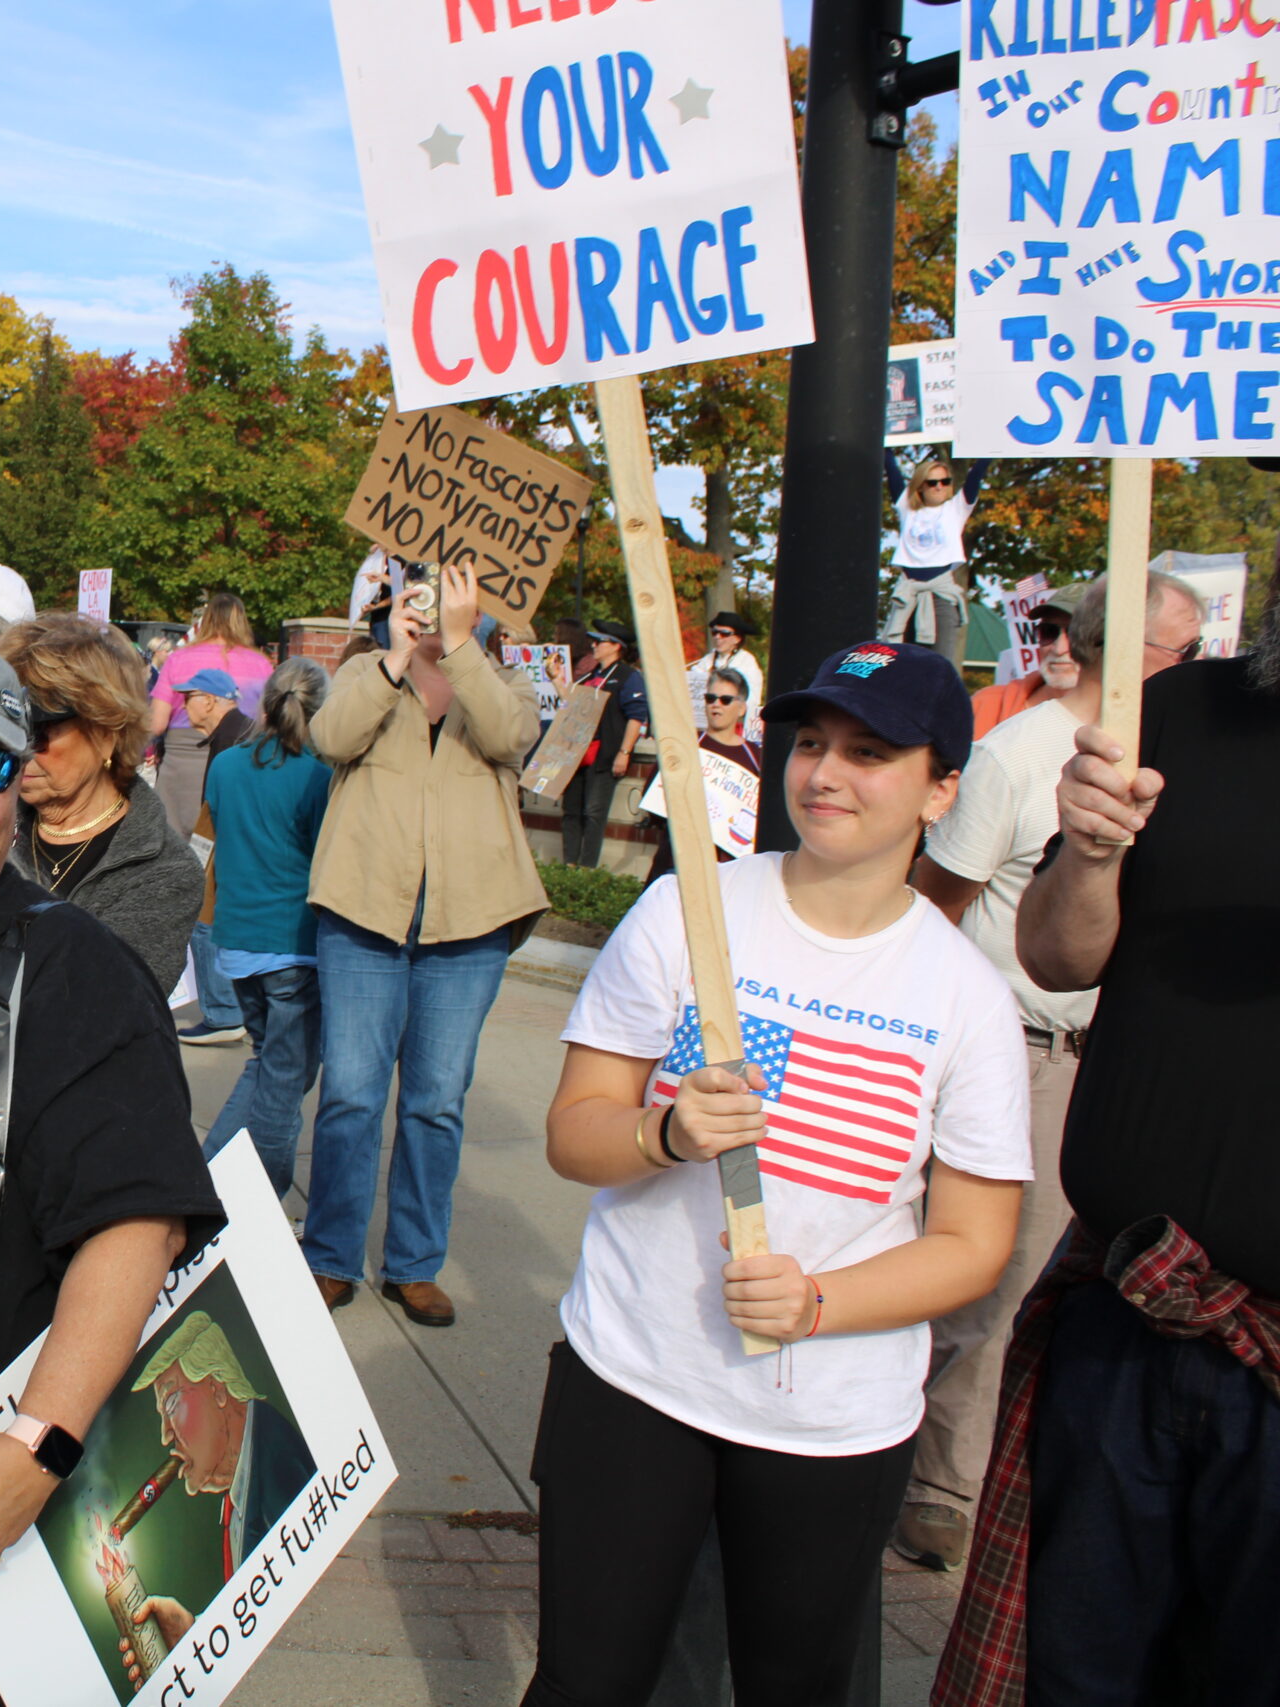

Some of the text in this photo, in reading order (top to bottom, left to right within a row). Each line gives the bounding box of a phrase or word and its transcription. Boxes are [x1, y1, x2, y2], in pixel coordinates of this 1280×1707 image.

[467, 50, 670, 196] YOUR
[412, 205, 765, 386] COURAGE
[968, 249, 1017, 297] AND
[1018, 240, 1069, 296] I
[1074, 239, 1141, 288] HAVE
[1006, 370, 1280, 446] SAME
[787, 991, 940, 1046] LACROSSE
[193, 1624, 229, 1675] to
[232, 1553, 283, 1638] get
[279, 1428, 376, 1567] fu#ked
